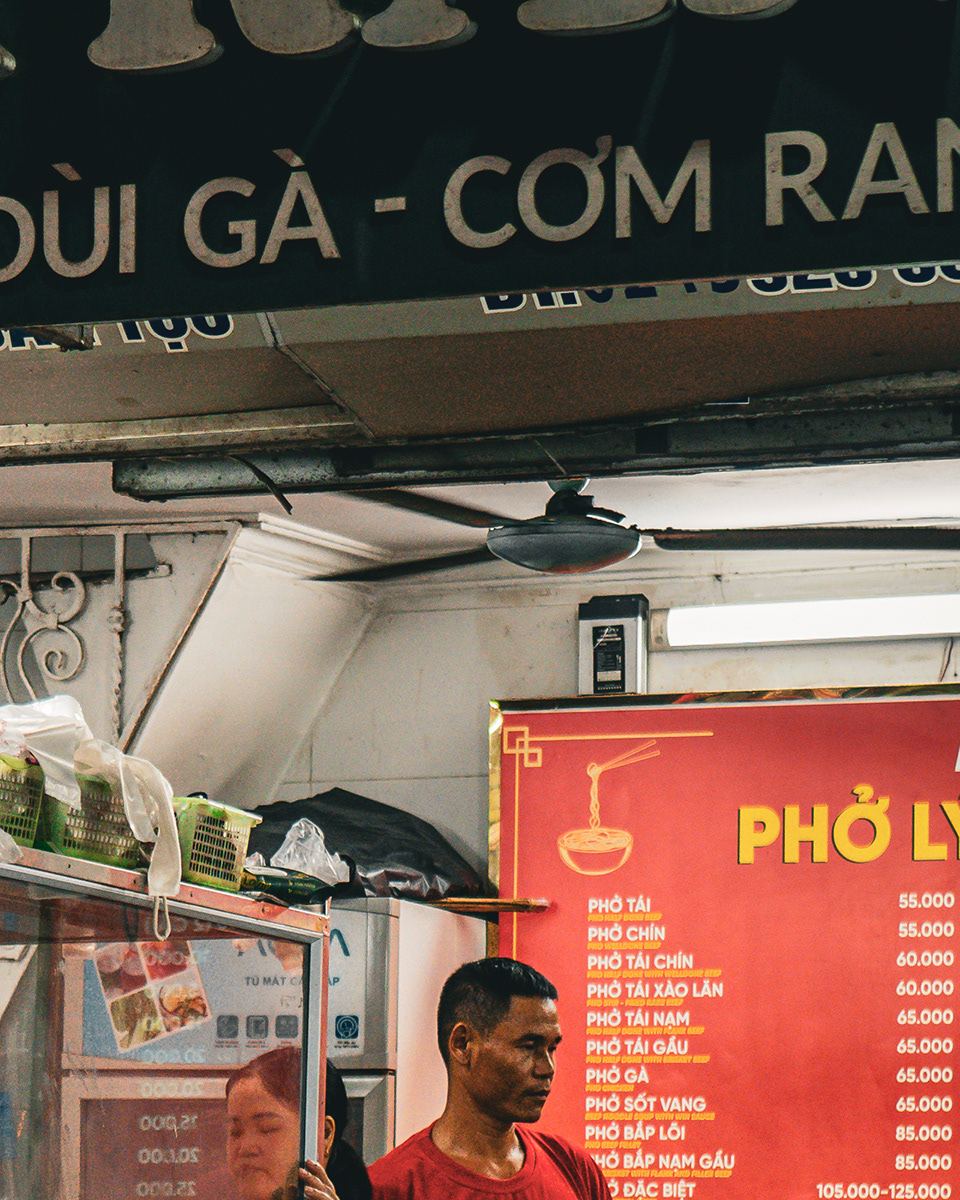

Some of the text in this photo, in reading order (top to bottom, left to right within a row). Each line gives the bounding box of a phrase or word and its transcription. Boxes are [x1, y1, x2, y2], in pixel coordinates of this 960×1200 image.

[183, 148, 340, 268] GÀ
[444, 135, 712, 248] CƠM
[738, 783, 891, 864] PHỞ
[588, 894, 651, 913] PHỞ TÁI
[898, 892, 955, 908] 55.000
[588, 923, 665, 941] PHỞ CHÍN
[898, 921, 955, 938] 55.000
[587, 951, 693, 969] PHỞ TÁI CHÍN
[896, 951, 954, 967] 60.000
[587, 979, 622, 998] PHỞ
[625, 979, 649, 998] TÁI
[654, 979, 689, 998] XÀO
[896, 980, 954, 996] 60.000
[586, 1008, 690, 1030] PHỞ TÁI NẠM
[897, 1009, 954, 1025] 65.000
[586, 1036, 621, 1055] PHỞ
[624, 1036, 649, 1055] TÁI
[896, 1038, 954, 1054] 65.000
[586, 1065, 649, 1083] PHỞ GÀ
[896, 1067, 953, 1083] 65.000
[585, 1093, 706, 1112] PHỞ SỐT VANG
[896, 1096, 953, 1112] 65.000
[585, 1121, 620, 1140] PHỞ
[624, 1120, 655, 1140] BẮP
[895, 1125, 953, 1141] 85.000
[591, 1150, 620, 1169] HỞ
[623, 1149, 655, 1169] BẮP
[659, 1154, 695, 1172] NẠM
[895, 1154, 952, 1171] 85.000
[623, 1179, 658, 1200] ĐẶC
[662, 1179, 696, 1200] BIỆT
[816, 1182, 952, 1200] 105.000-125.000
